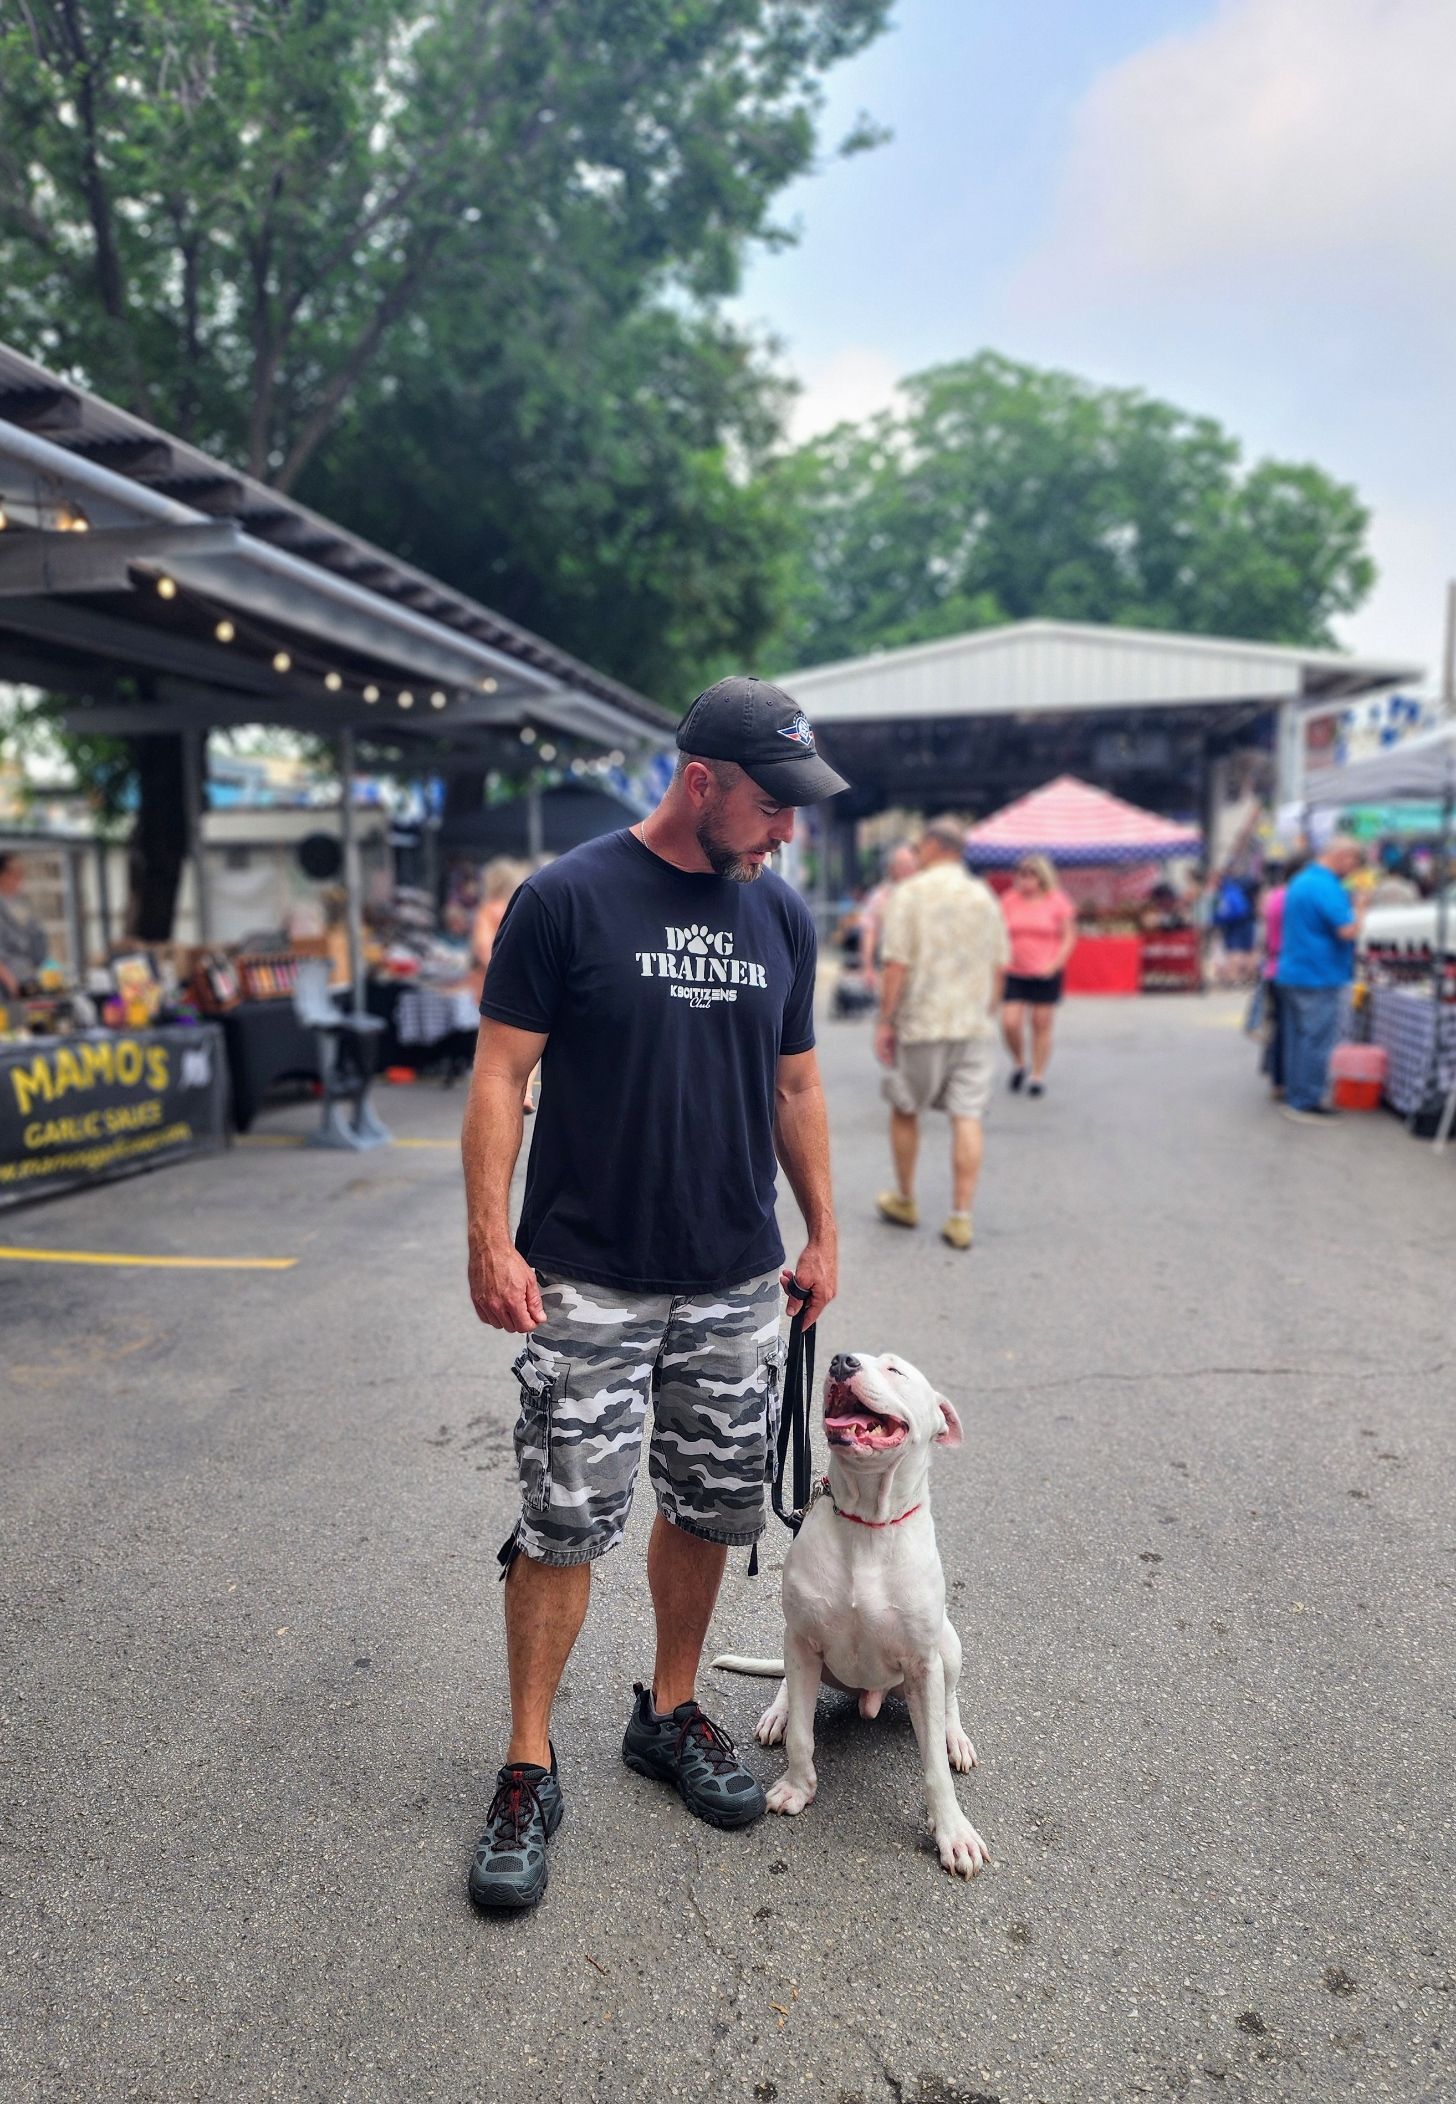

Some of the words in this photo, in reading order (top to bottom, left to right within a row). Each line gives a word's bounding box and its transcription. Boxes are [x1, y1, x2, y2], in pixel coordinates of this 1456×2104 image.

[635, 952, 768, 988] TRAINER
[689, 996, 711, 1008] Club
[10, 1040, 170, 1116] MAMO'S
